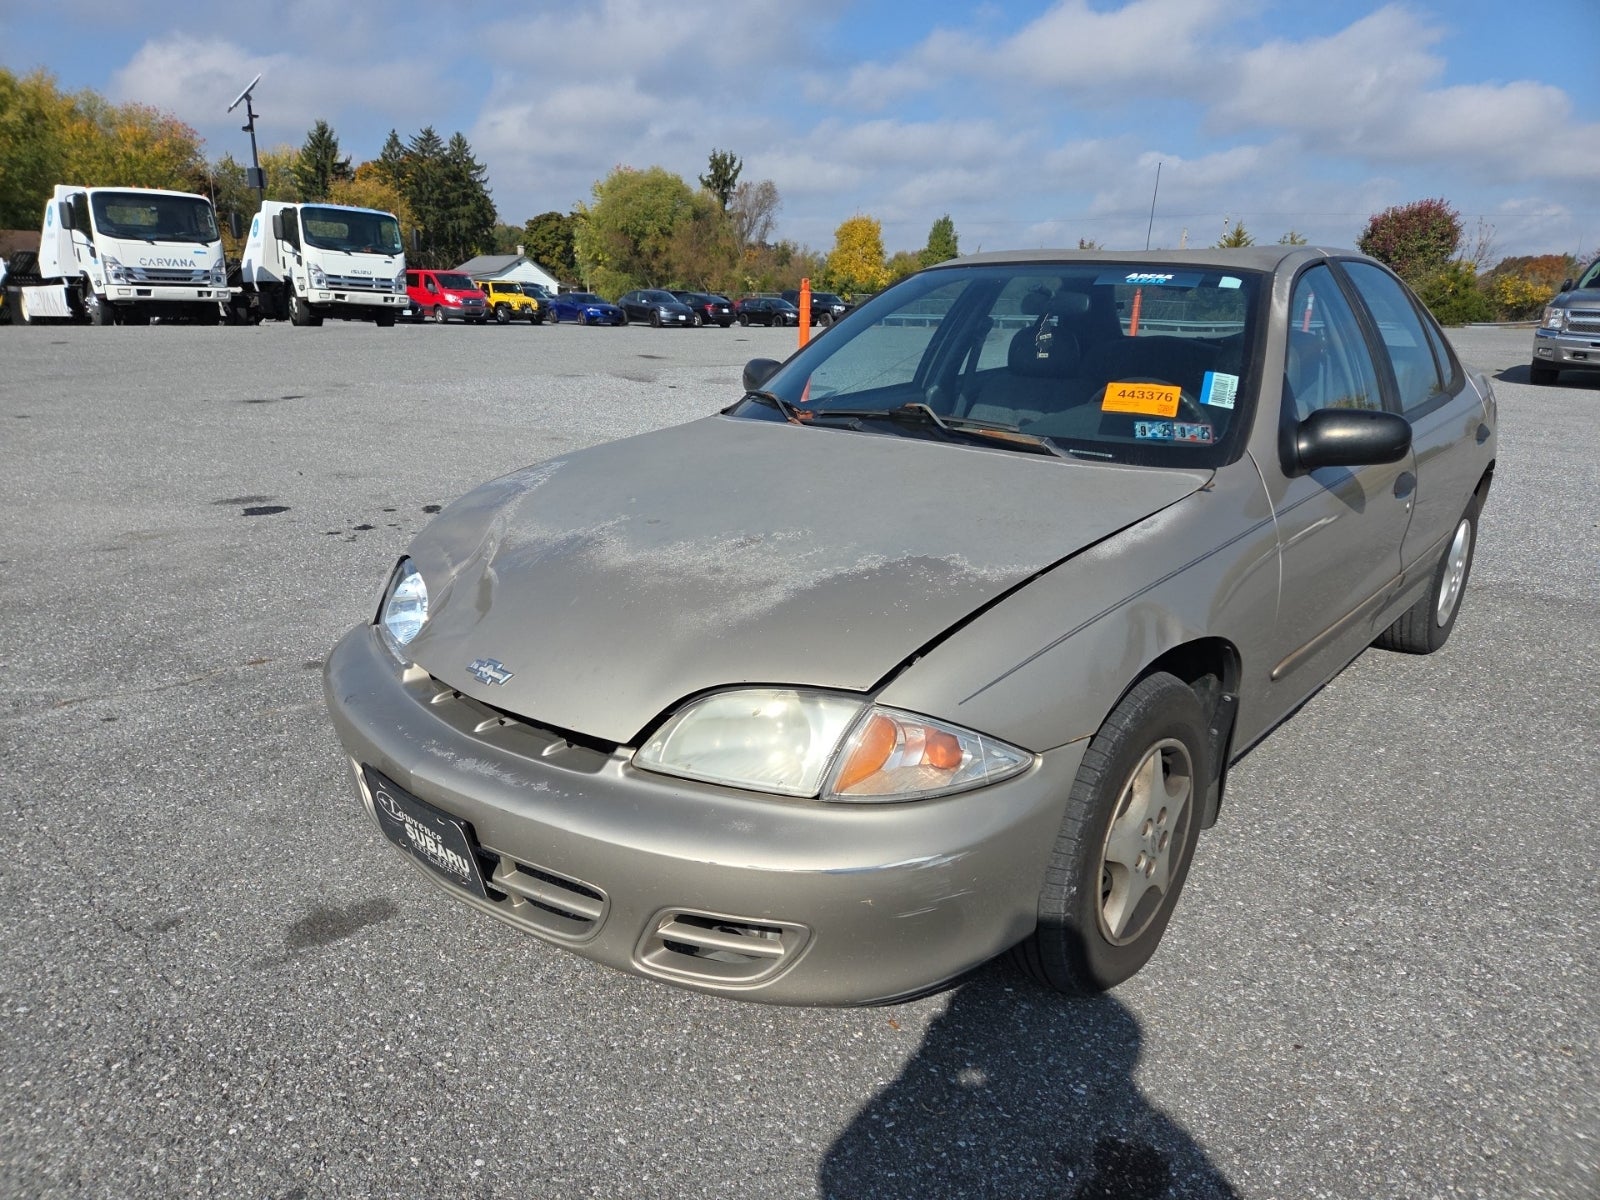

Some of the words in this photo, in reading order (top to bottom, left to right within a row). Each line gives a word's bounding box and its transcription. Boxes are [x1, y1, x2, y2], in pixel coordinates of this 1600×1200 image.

[139, 257, 197, 268] CARVANA
[1117, 389, 1174, 402] 443376
[1140, 425, 1147, 437] 9
[1179, 426, 1186, 438] 9
[388, 798, 442, 843] Lawrence
[404, 822, 470, 873] SUBARU
